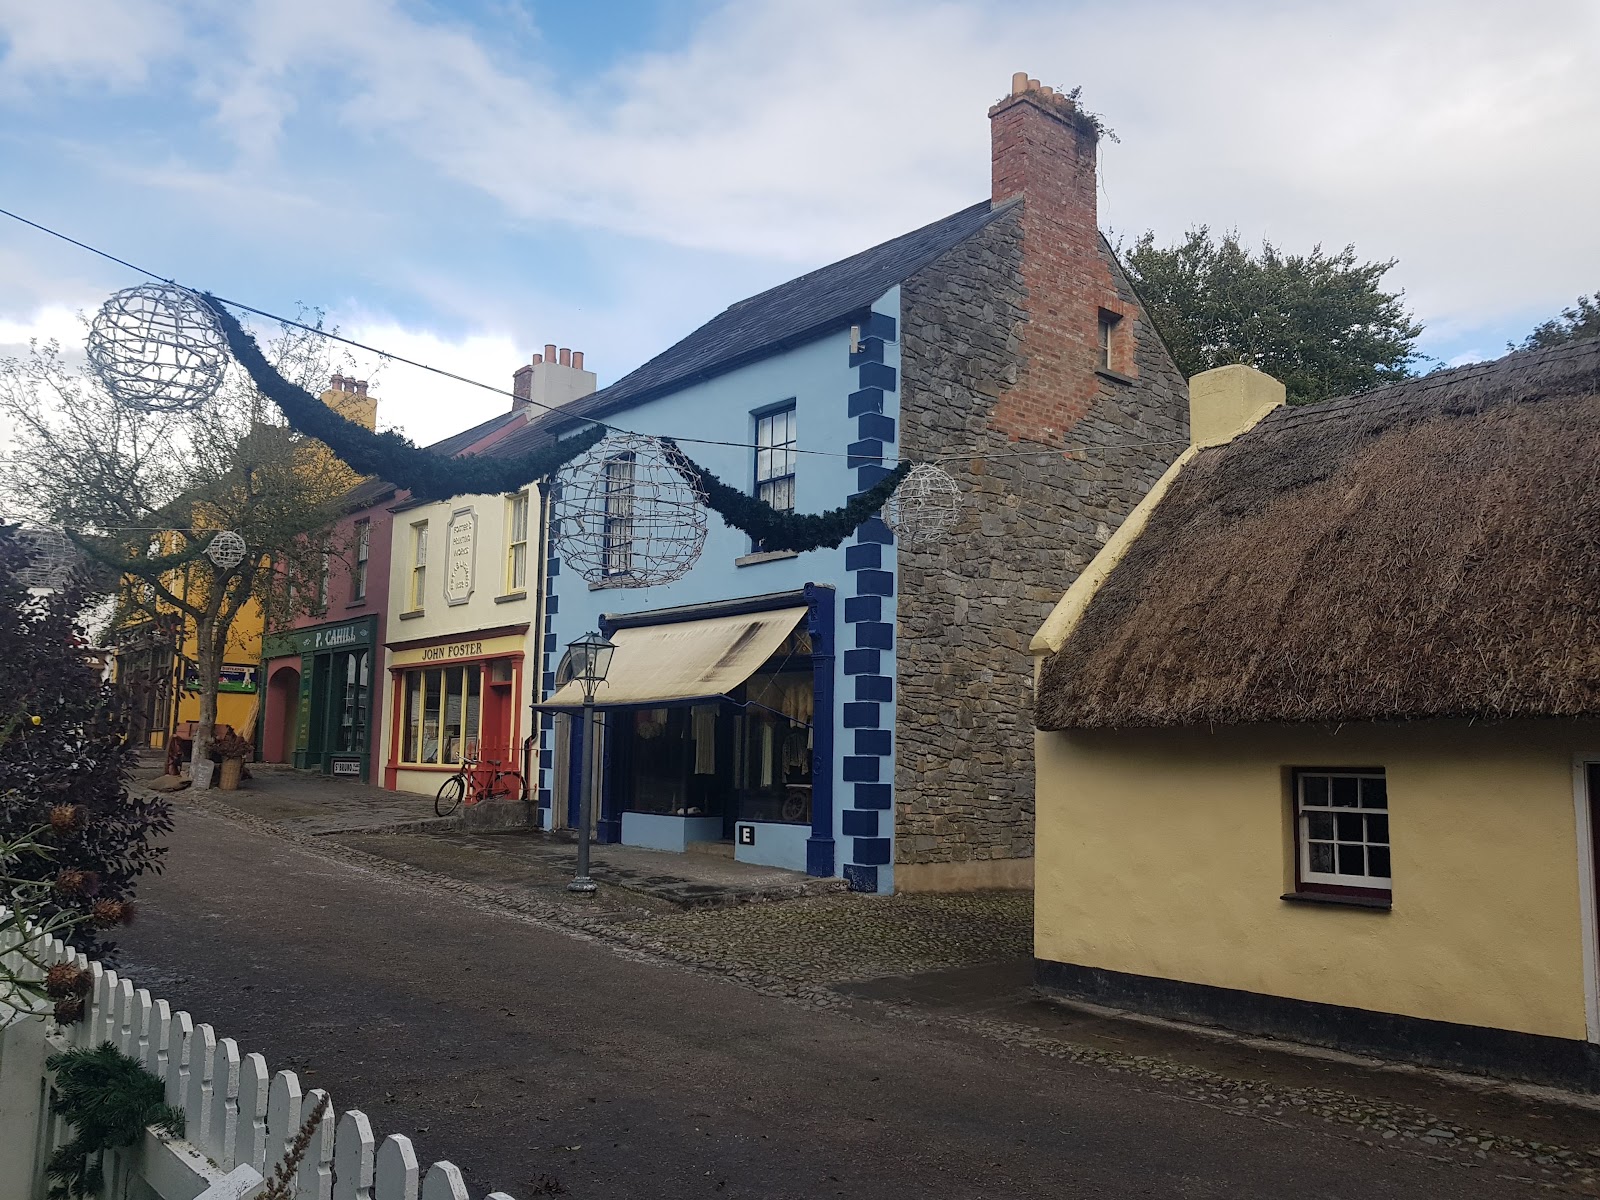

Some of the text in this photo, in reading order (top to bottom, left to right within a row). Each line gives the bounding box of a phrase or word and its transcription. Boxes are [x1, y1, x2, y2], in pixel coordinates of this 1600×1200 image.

[315, 626, 356, 648] P. CAHILL
[421, 642, 483, 661] JOHN FOSTER
[742, 827, 751, 843] E
